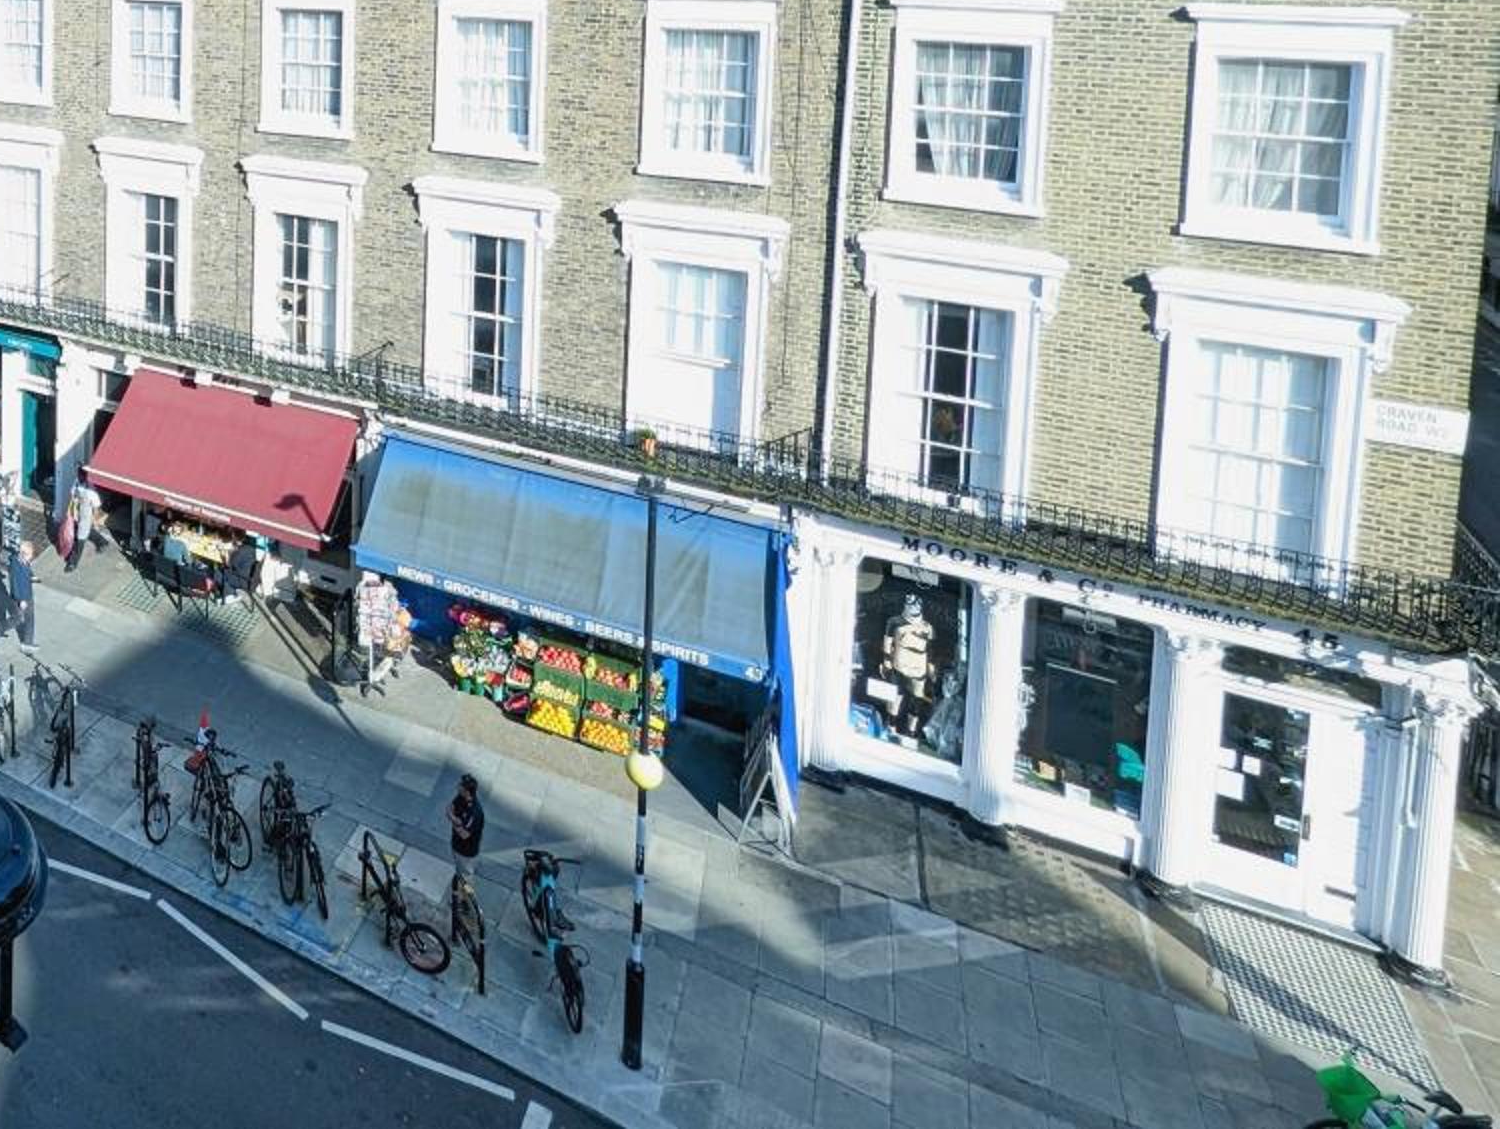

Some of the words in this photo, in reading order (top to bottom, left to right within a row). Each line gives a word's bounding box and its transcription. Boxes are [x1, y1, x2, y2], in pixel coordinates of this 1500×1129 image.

[901, 535, 1019, 576] MOORE
[1037, 568, 1055, 583] &
[397, 565, 435, 585] NEWS
[443, 580, 520, 610] GROCERIES
[529, 603, 576, 628] WINES
[585, 621, 635, 645] BEERS
[651, 640, 709, 667] SPIRITS
[1137, 594, 1267, 632] PHARMACY
